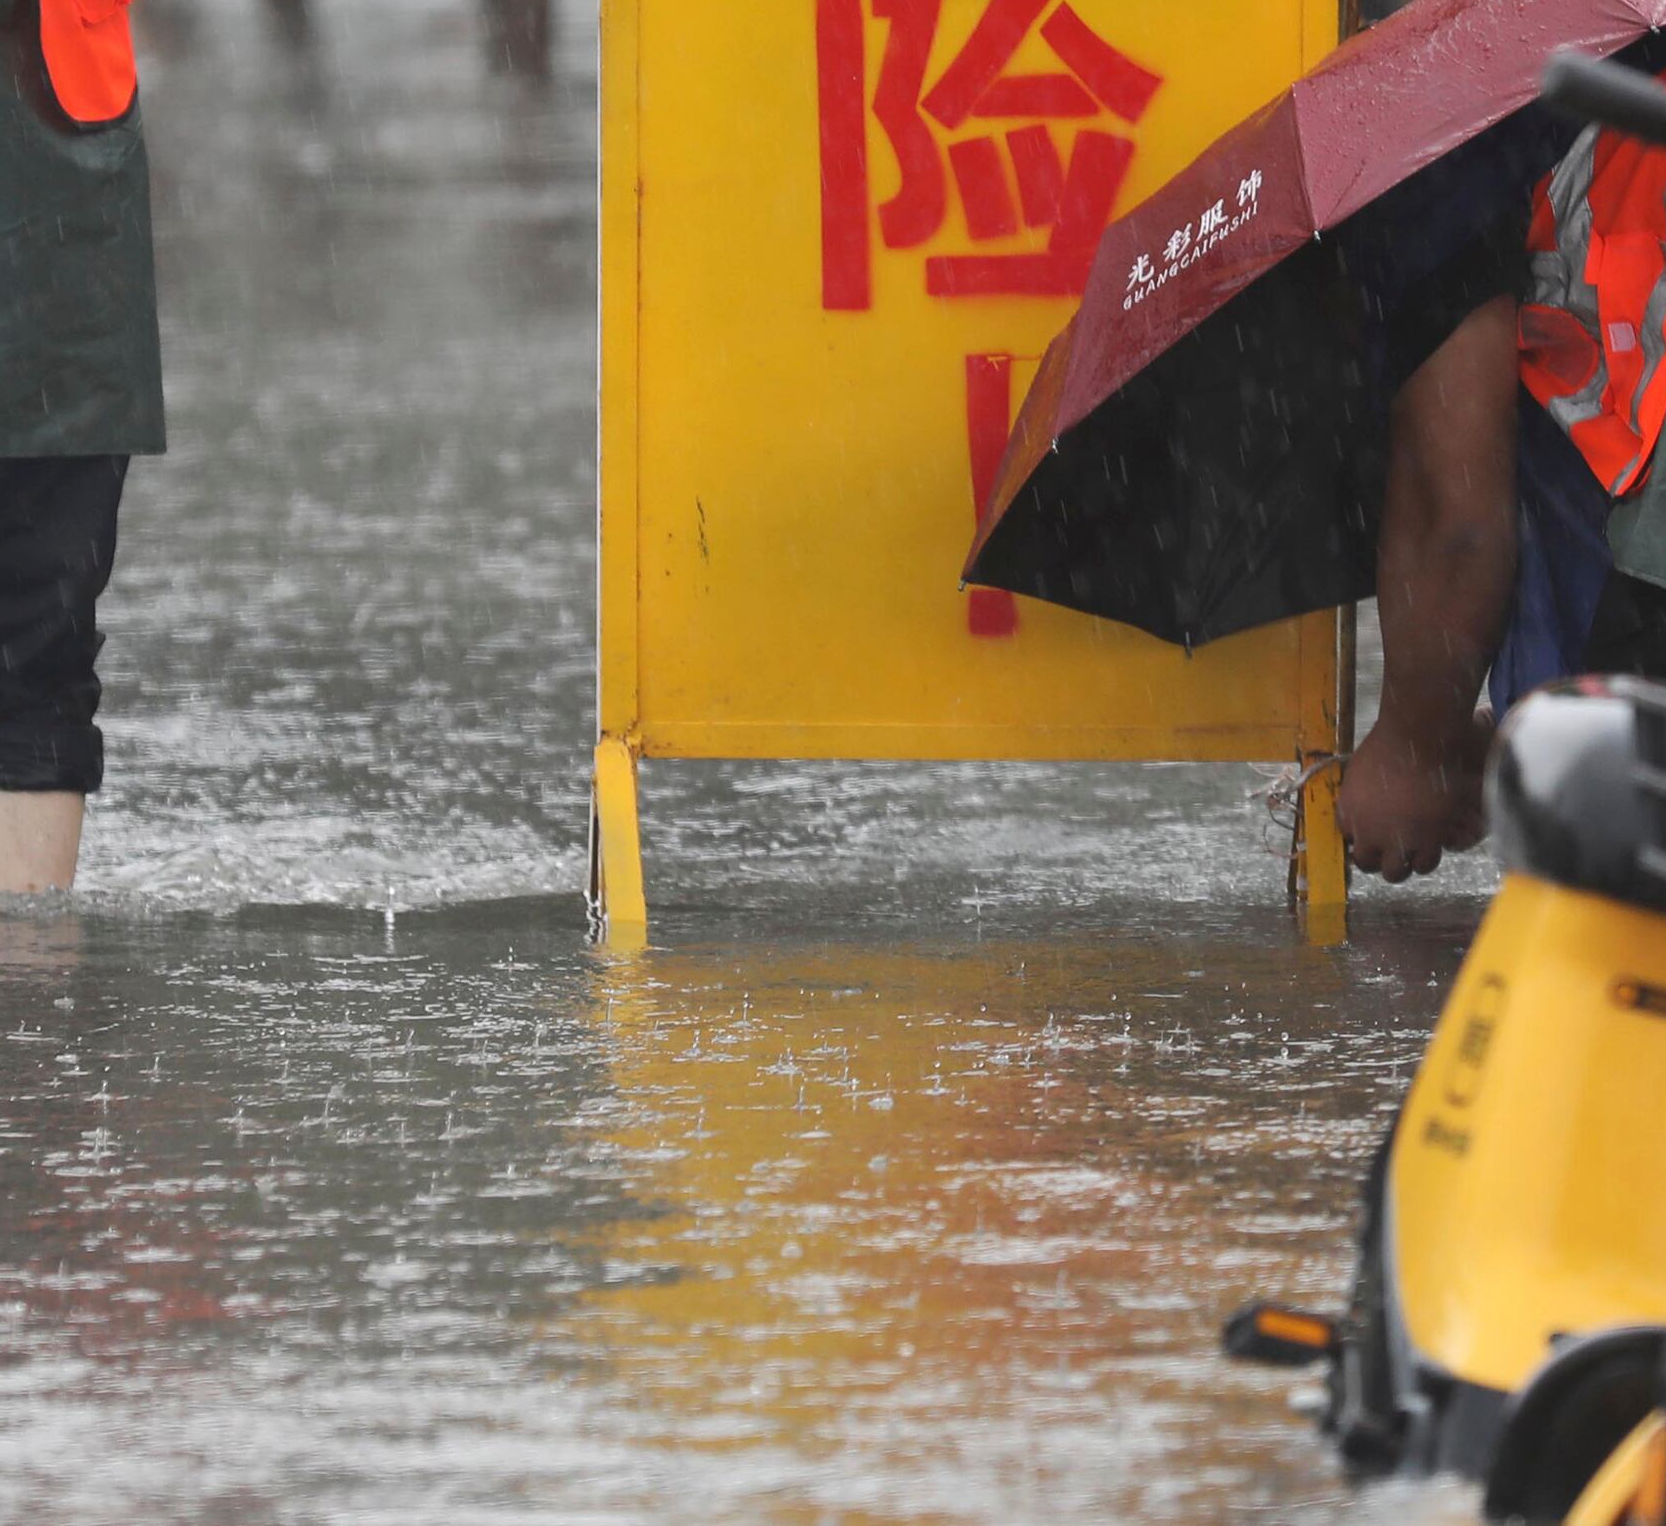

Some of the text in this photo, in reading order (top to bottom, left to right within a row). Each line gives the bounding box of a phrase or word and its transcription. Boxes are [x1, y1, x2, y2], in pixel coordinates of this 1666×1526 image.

[1122, 200, 1260, 311] GUANGCAIFUSHI
[1125, 169, 1263, 292] 光彩服饰
